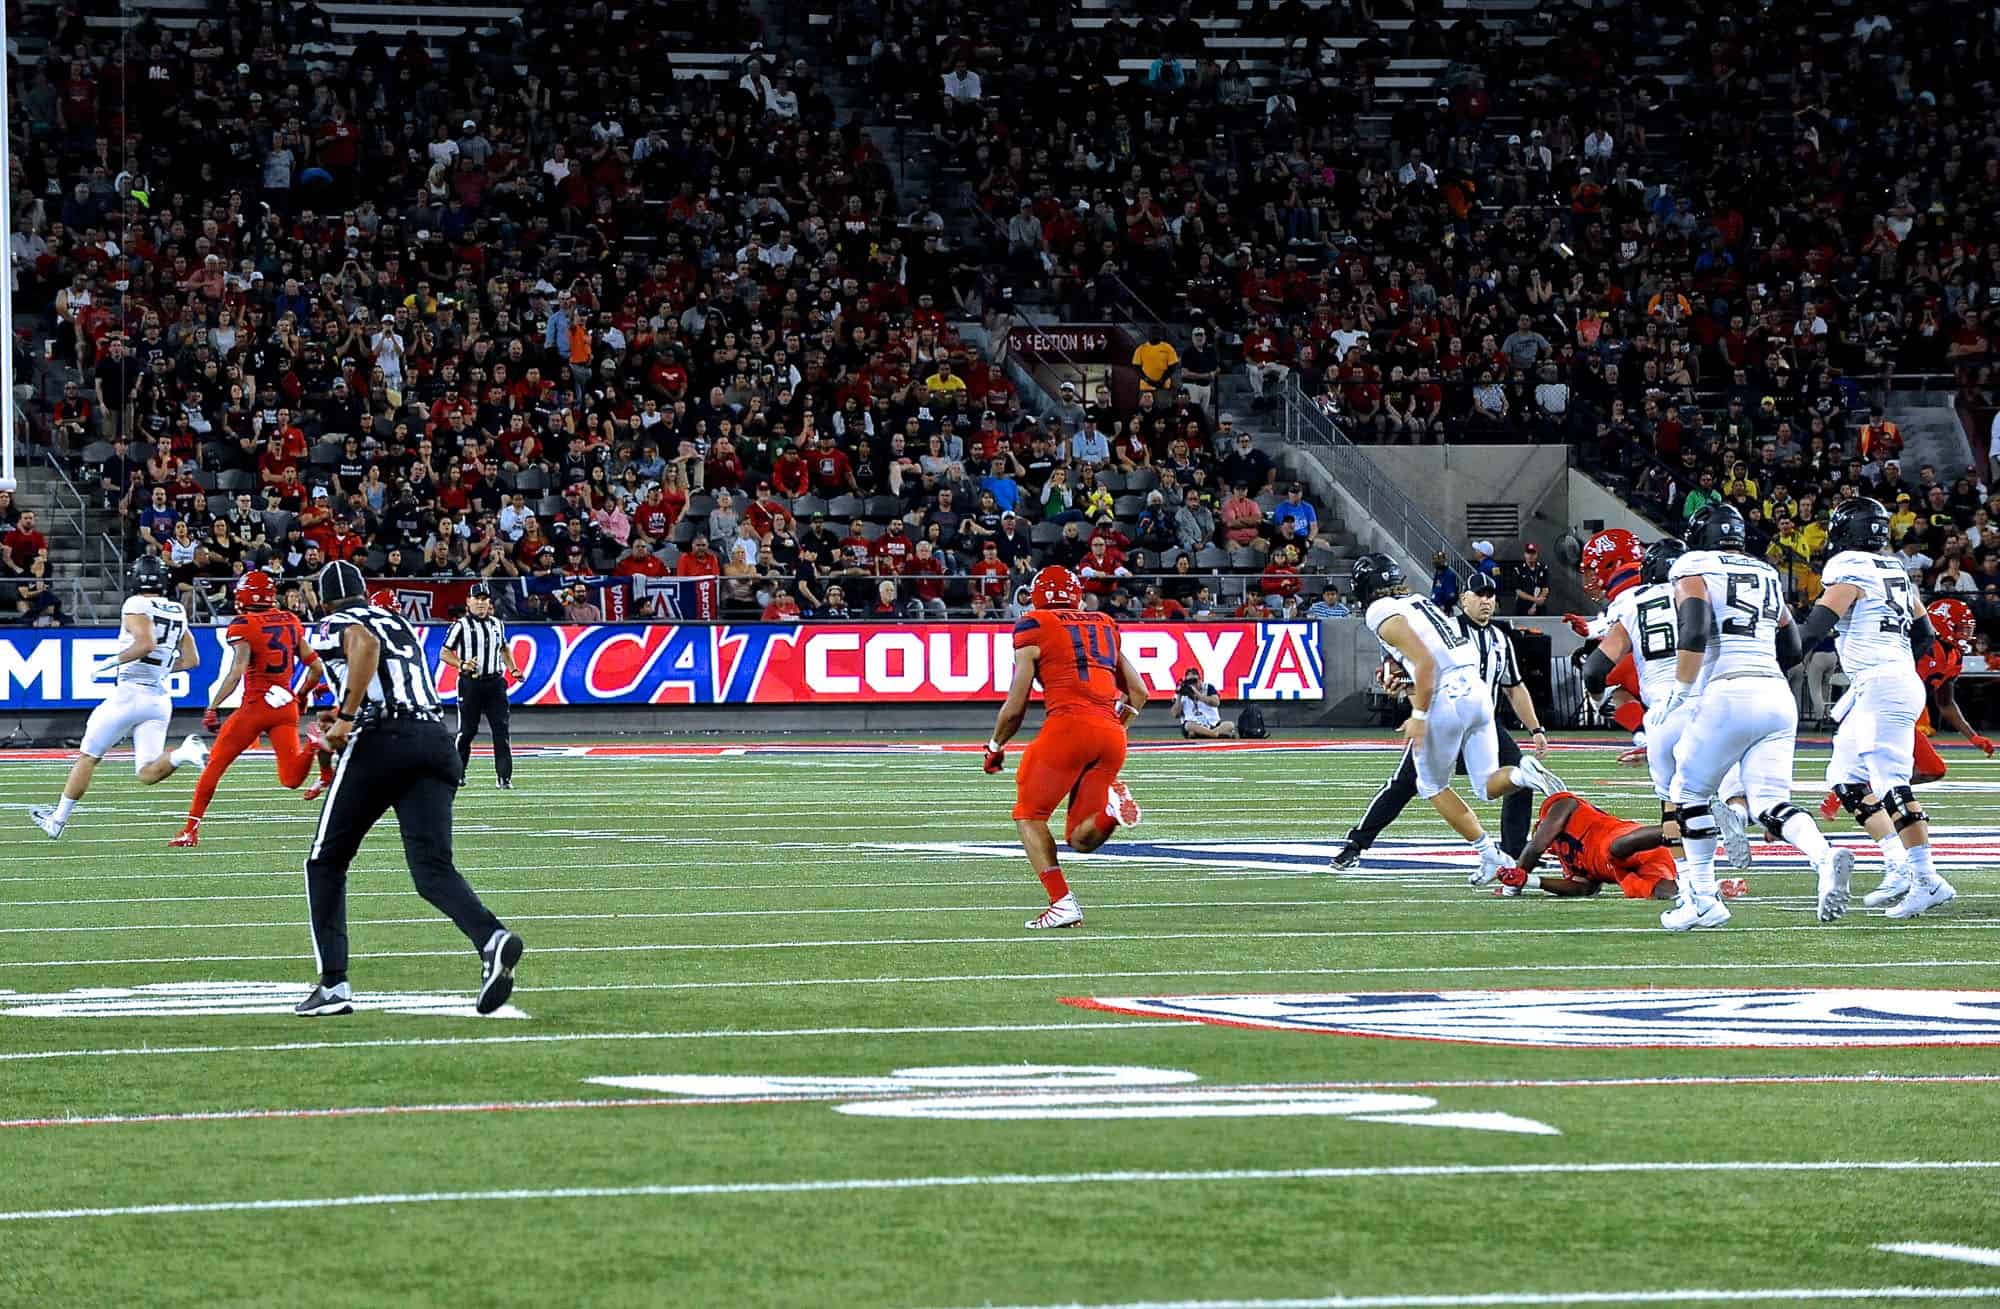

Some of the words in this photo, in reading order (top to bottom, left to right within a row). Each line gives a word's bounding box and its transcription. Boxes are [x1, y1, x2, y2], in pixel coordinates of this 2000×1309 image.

[1082, 334, 1095, 350] 14
[1637, 595, 1679, 662] 6
[1721, 572, 1782, 637] 54
[261, 625, 298, 674] 31
[804, 631, 1244, 695] COURY
[1063, 623, 1118, 682] 14
